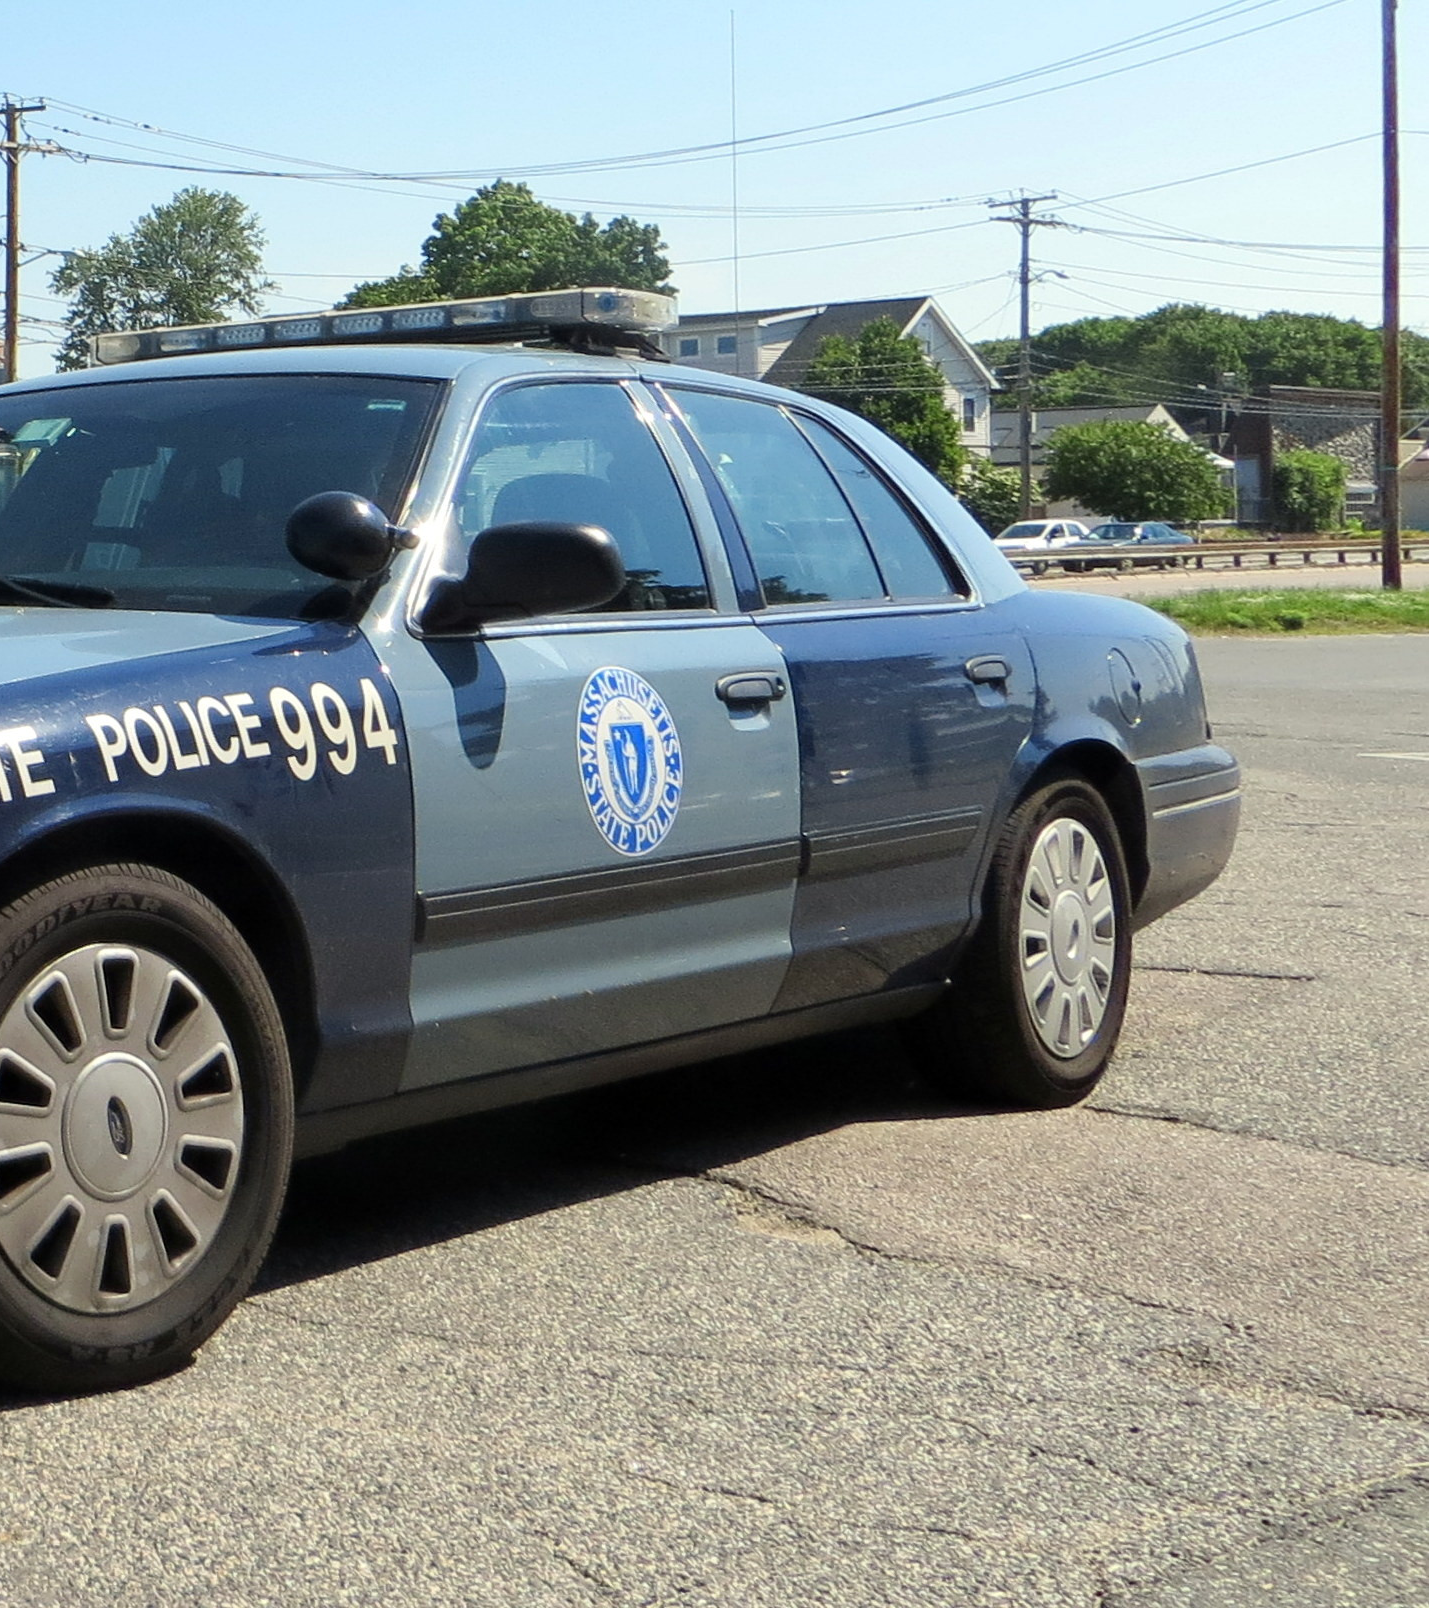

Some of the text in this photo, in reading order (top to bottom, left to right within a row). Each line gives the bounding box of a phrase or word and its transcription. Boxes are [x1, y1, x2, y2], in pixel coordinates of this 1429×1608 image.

[85, 692, 272, 783] POLICE
[269, 677, 399, 781] 994
[579, 670, 679, 764] MASSACHUSETTS
[585, 766, 681, 852] STATE POLICE
